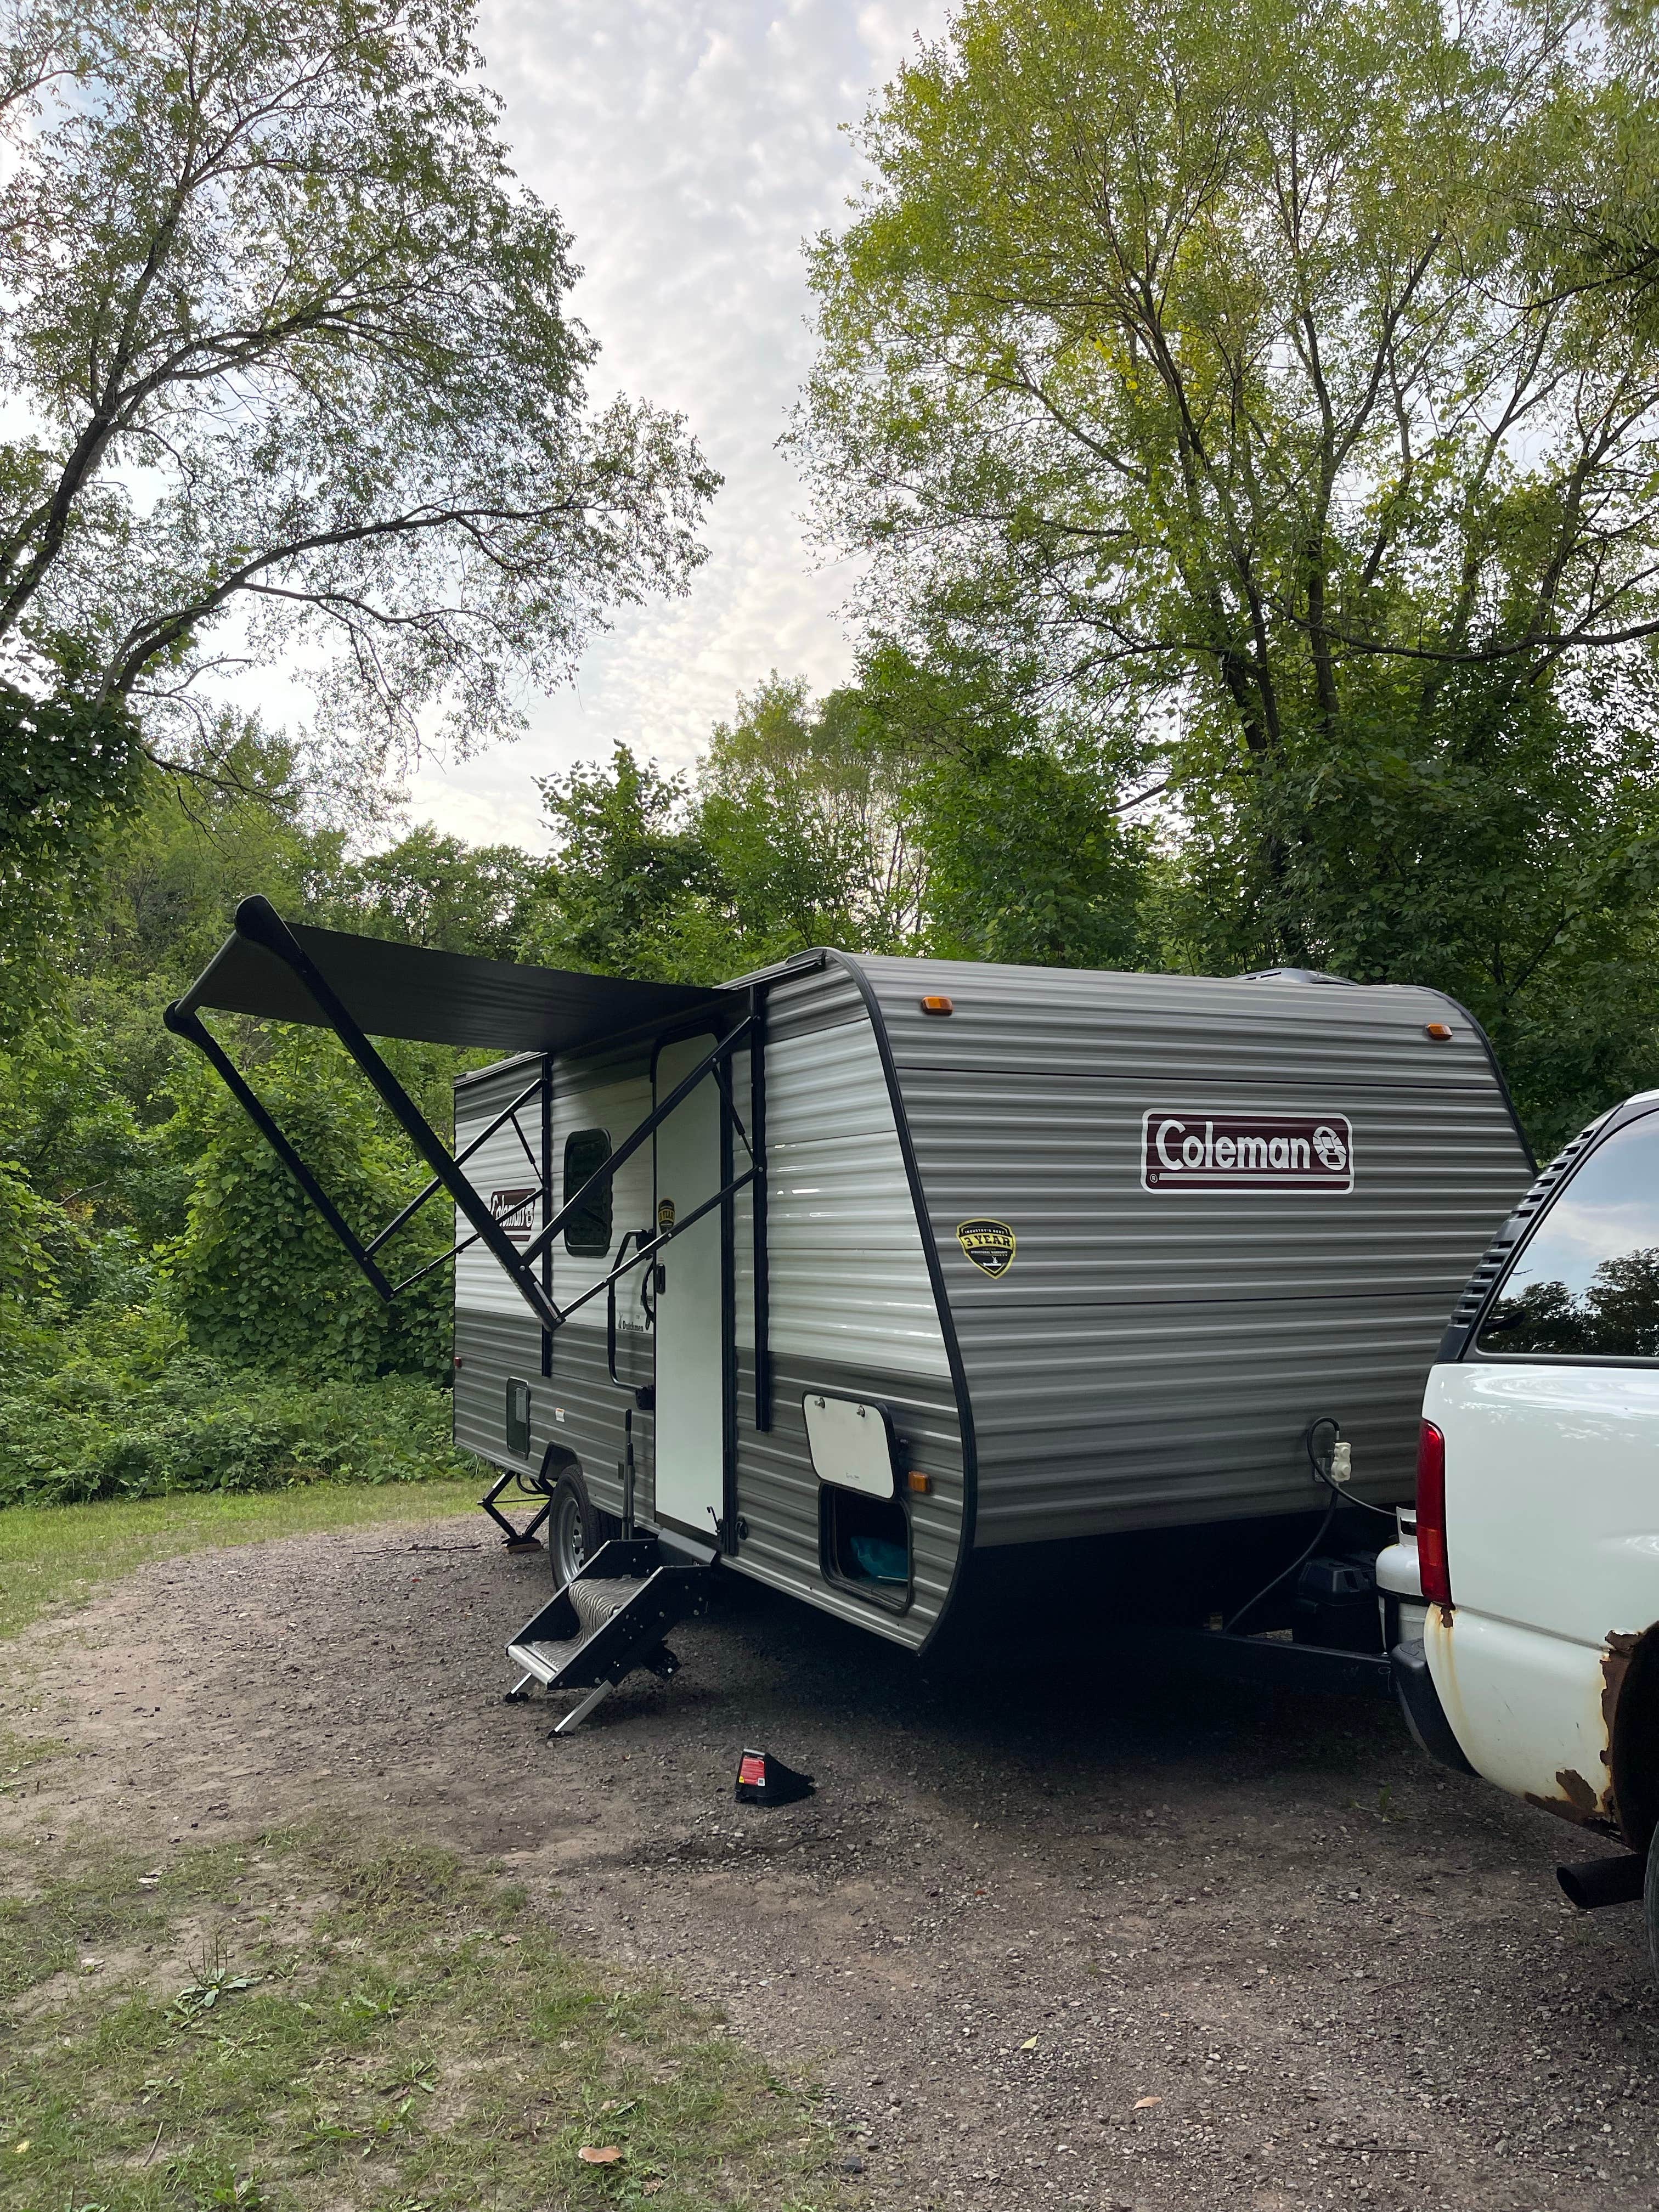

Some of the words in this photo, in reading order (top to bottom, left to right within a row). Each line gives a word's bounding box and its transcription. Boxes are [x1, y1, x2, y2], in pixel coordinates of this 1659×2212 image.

[1155, 1119, 1311, 1170] Coleman
[964, 1237, 973, 1246] 3
[974, 1235, 1011, 1247] YEAR
[623, 1321, 644, 1332] Dutchmen
